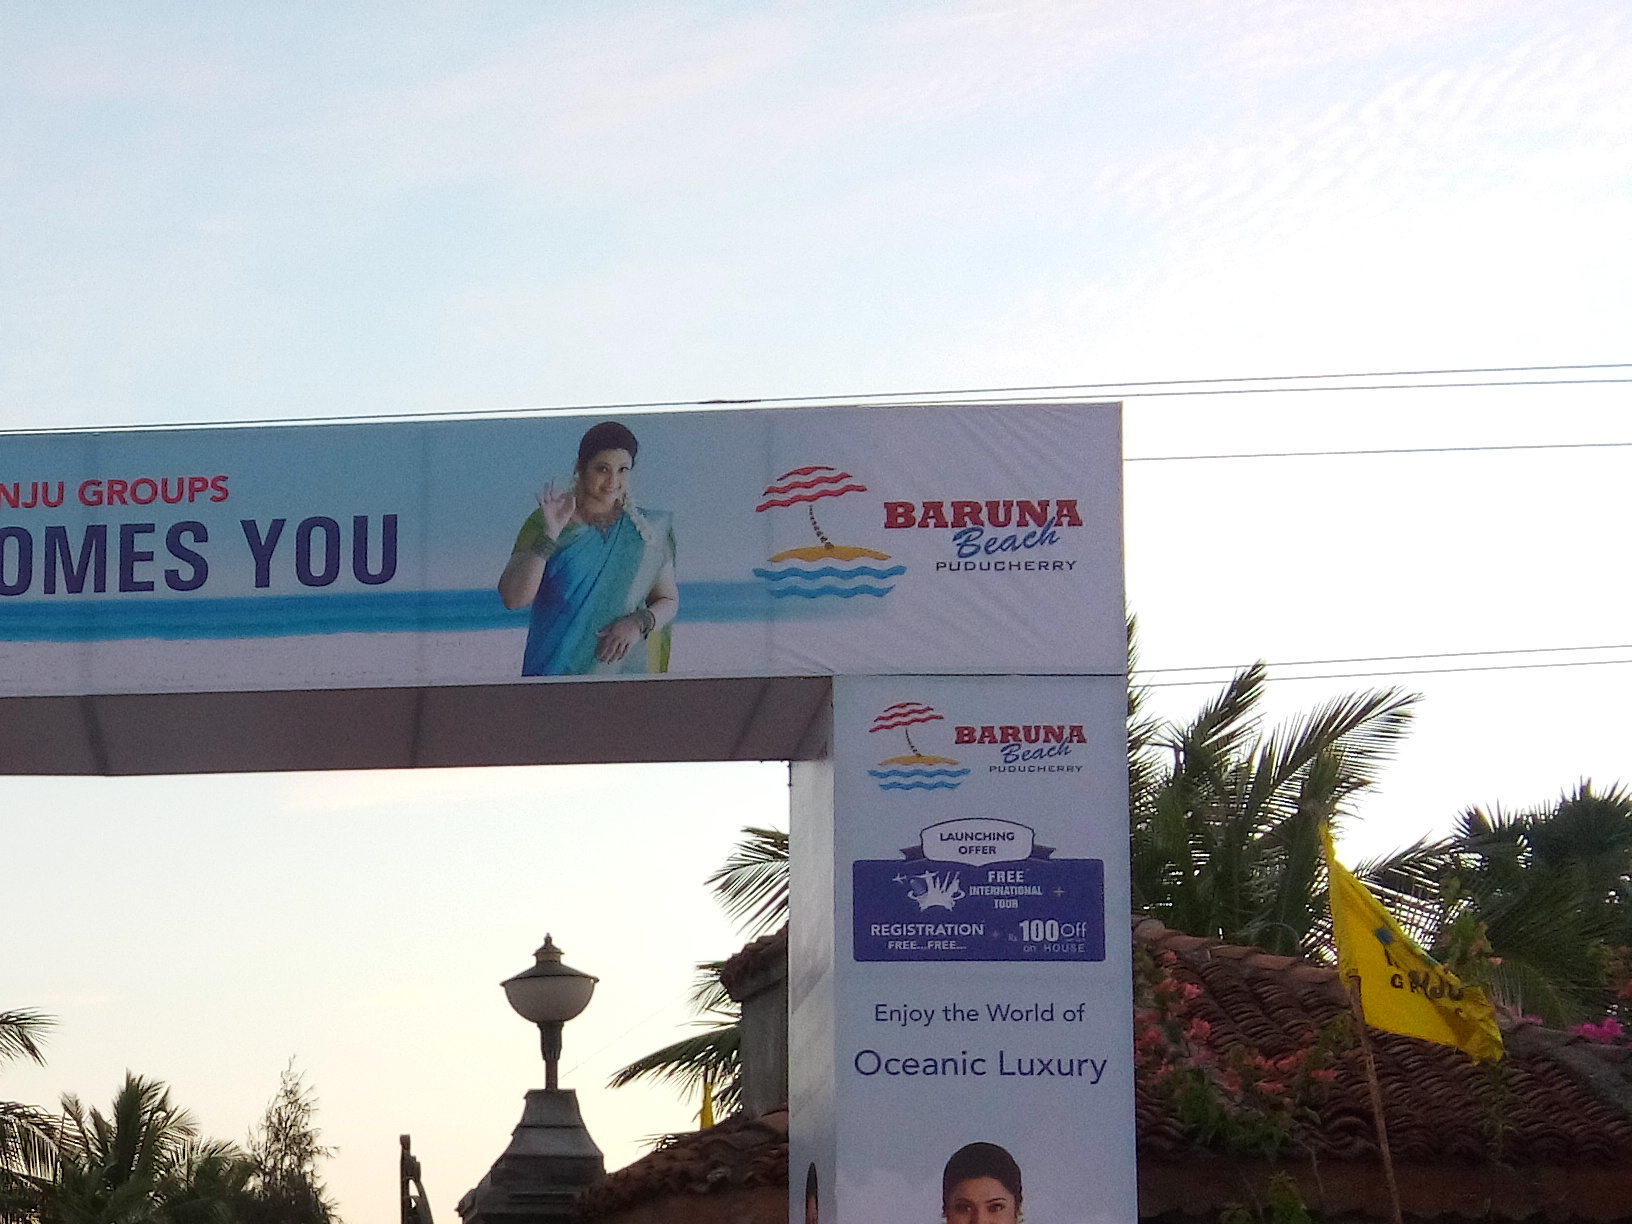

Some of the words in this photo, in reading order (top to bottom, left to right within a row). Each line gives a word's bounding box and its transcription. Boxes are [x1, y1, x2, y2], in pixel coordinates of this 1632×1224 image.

[78, 475, 229, 507] GROUPS
[883, 499, 1083, 529] BARUNA
[952, 516, 1060, 559] Beach
[240, 513, 398, 589] YOU
[936, 560, 1077, 571] PUDUCHERRY
[954, 725, 1088, 744] BARUNA
[1000, 736, 1072, 764] Beach
[989, 765, 1083, 773] PUDUCHERRY
[939, 831, 1015, 843] LAUNCHING
[958, 844, 997, 856] OFFER
[988, 870, 1024, 883] FREE
[969, 886, 1043, 896] INTERNATIONAL
[994, 899, 1018, 910] TOUR
[870, 923, 985, 936] REGISTRATION
[1023, 945, 1037, 953] on
[1044, 943, 1086, 953] HOUSE
[874, 1002, 935, 1027] Enjoy
[942, 1003, 980, 1022] the
[985, 1003, 1054, 1022] World
[1062, 1002, 1086, 1022] of
[854, 1049, 986, 1077] Oceanic
[999, 1050, 1108, 1085] Luxury
